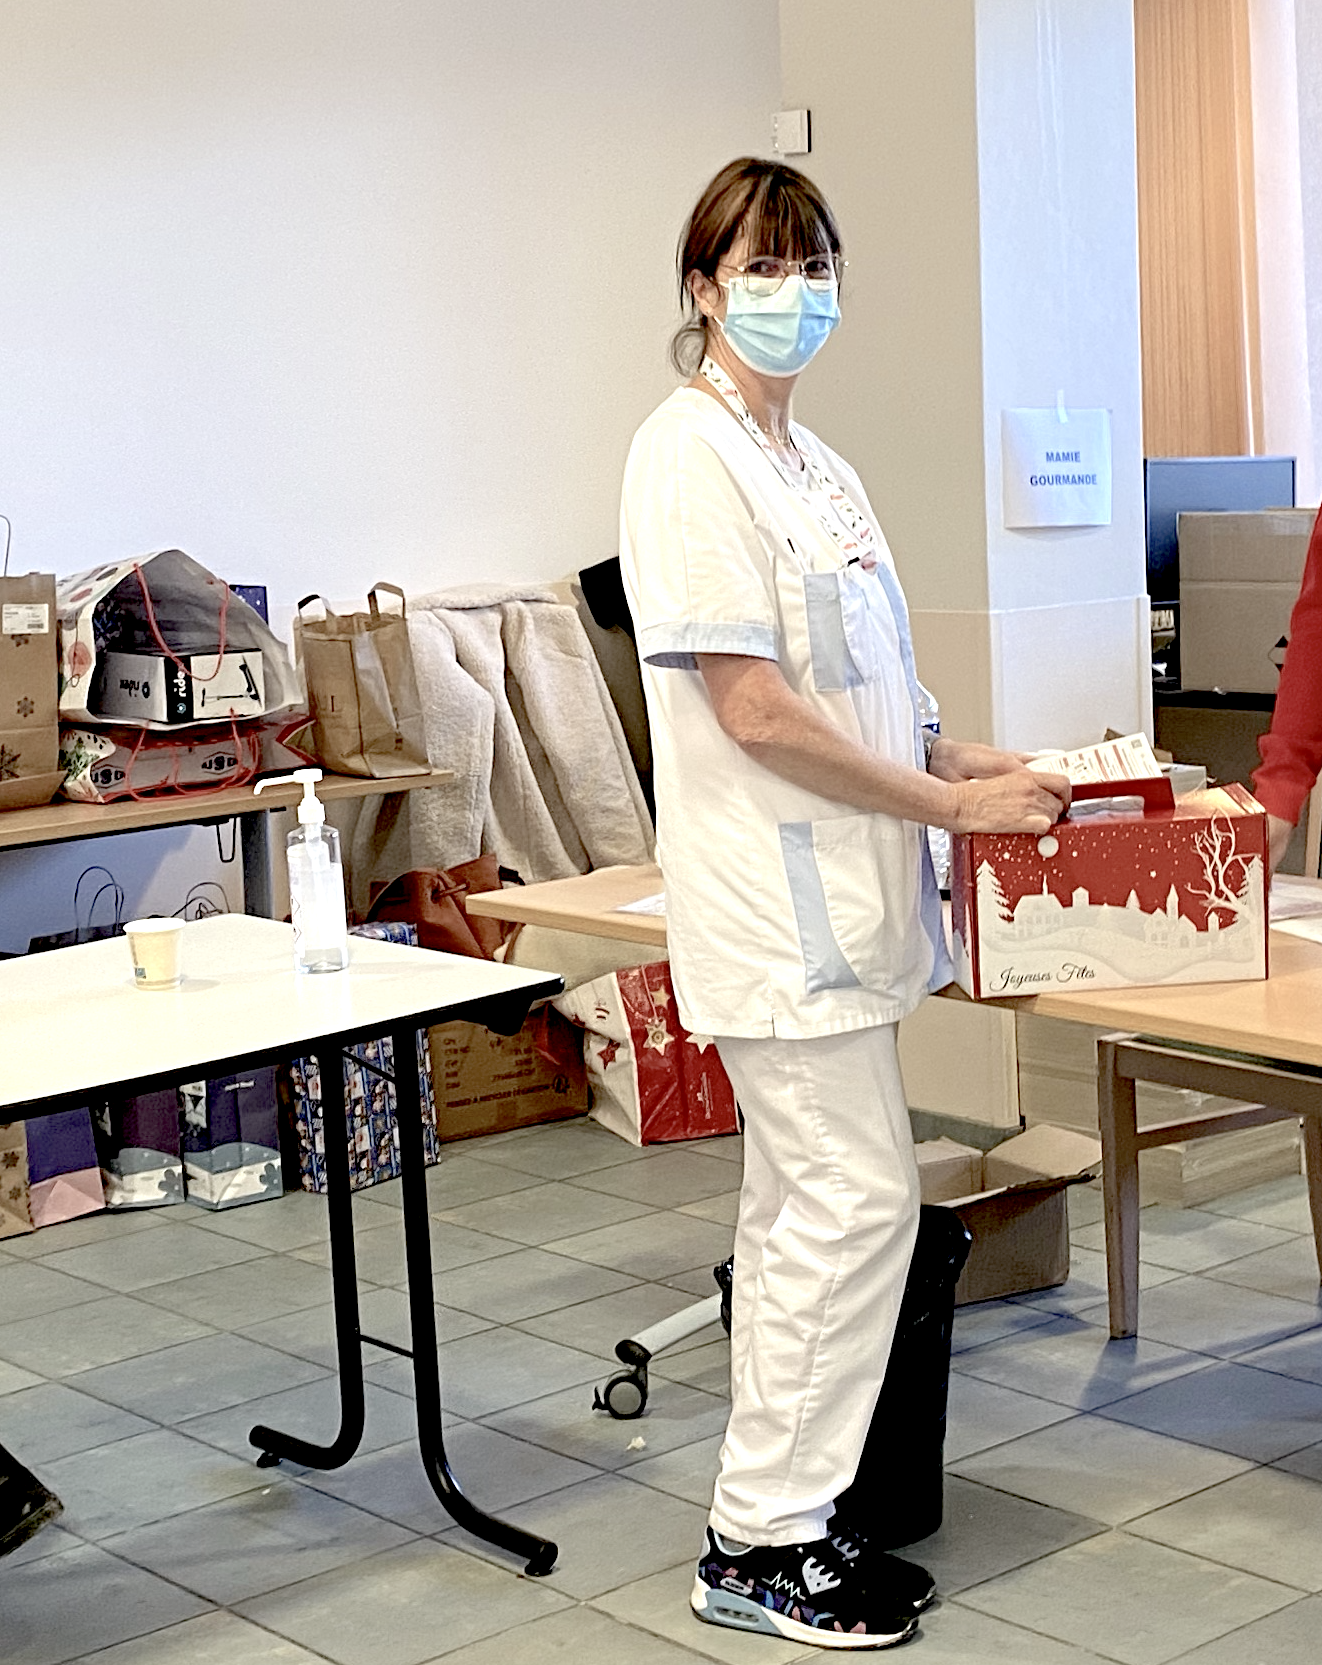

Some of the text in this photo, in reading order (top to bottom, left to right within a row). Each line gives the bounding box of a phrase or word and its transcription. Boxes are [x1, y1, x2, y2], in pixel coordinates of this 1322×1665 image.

[1045, 450, 1081, 463] MAMIE
[1029, 473, 1097, 487] GOURMANDE
[989, 966, 1052, 993] Joyeuses
